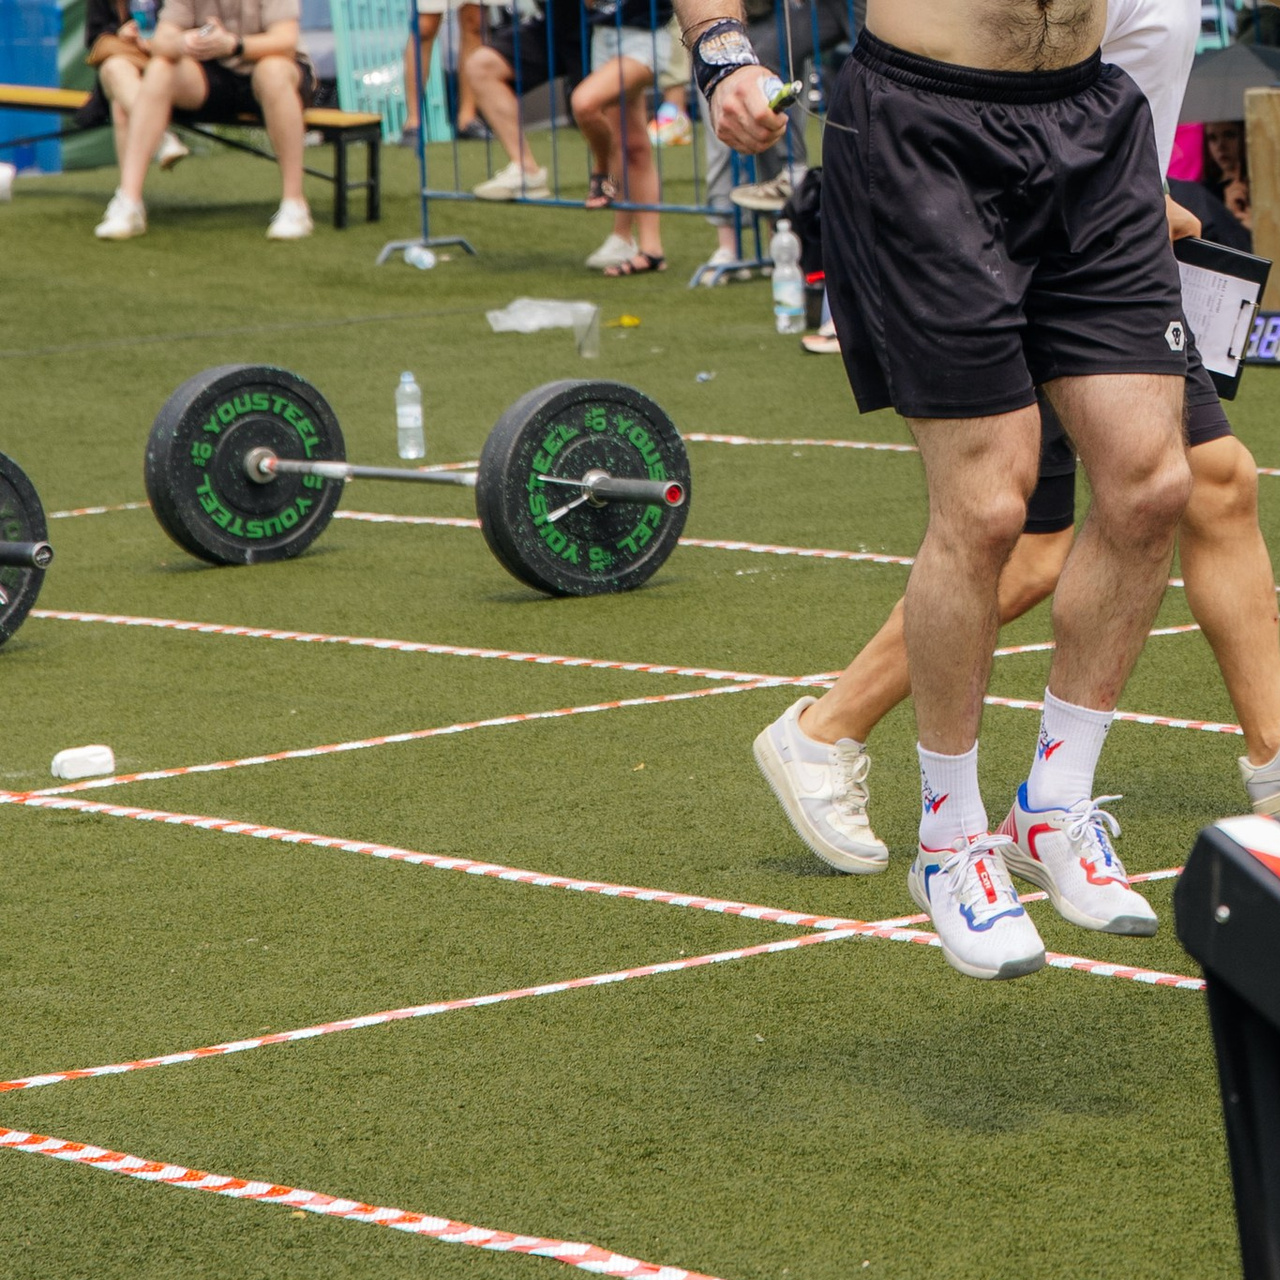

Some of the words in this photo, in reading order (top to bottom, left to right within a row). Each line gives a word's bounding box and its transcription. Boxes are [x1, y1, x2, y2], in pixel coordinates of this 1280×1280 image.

[191, 441, 212, 460] 10
[203, 393, 320, 458] YOUSTEEL
[591, 407, 606, 432] 10
[196, 473, 312, 539] YOUSTEEL
[614, 413, 668, 554] YOUSEEL
